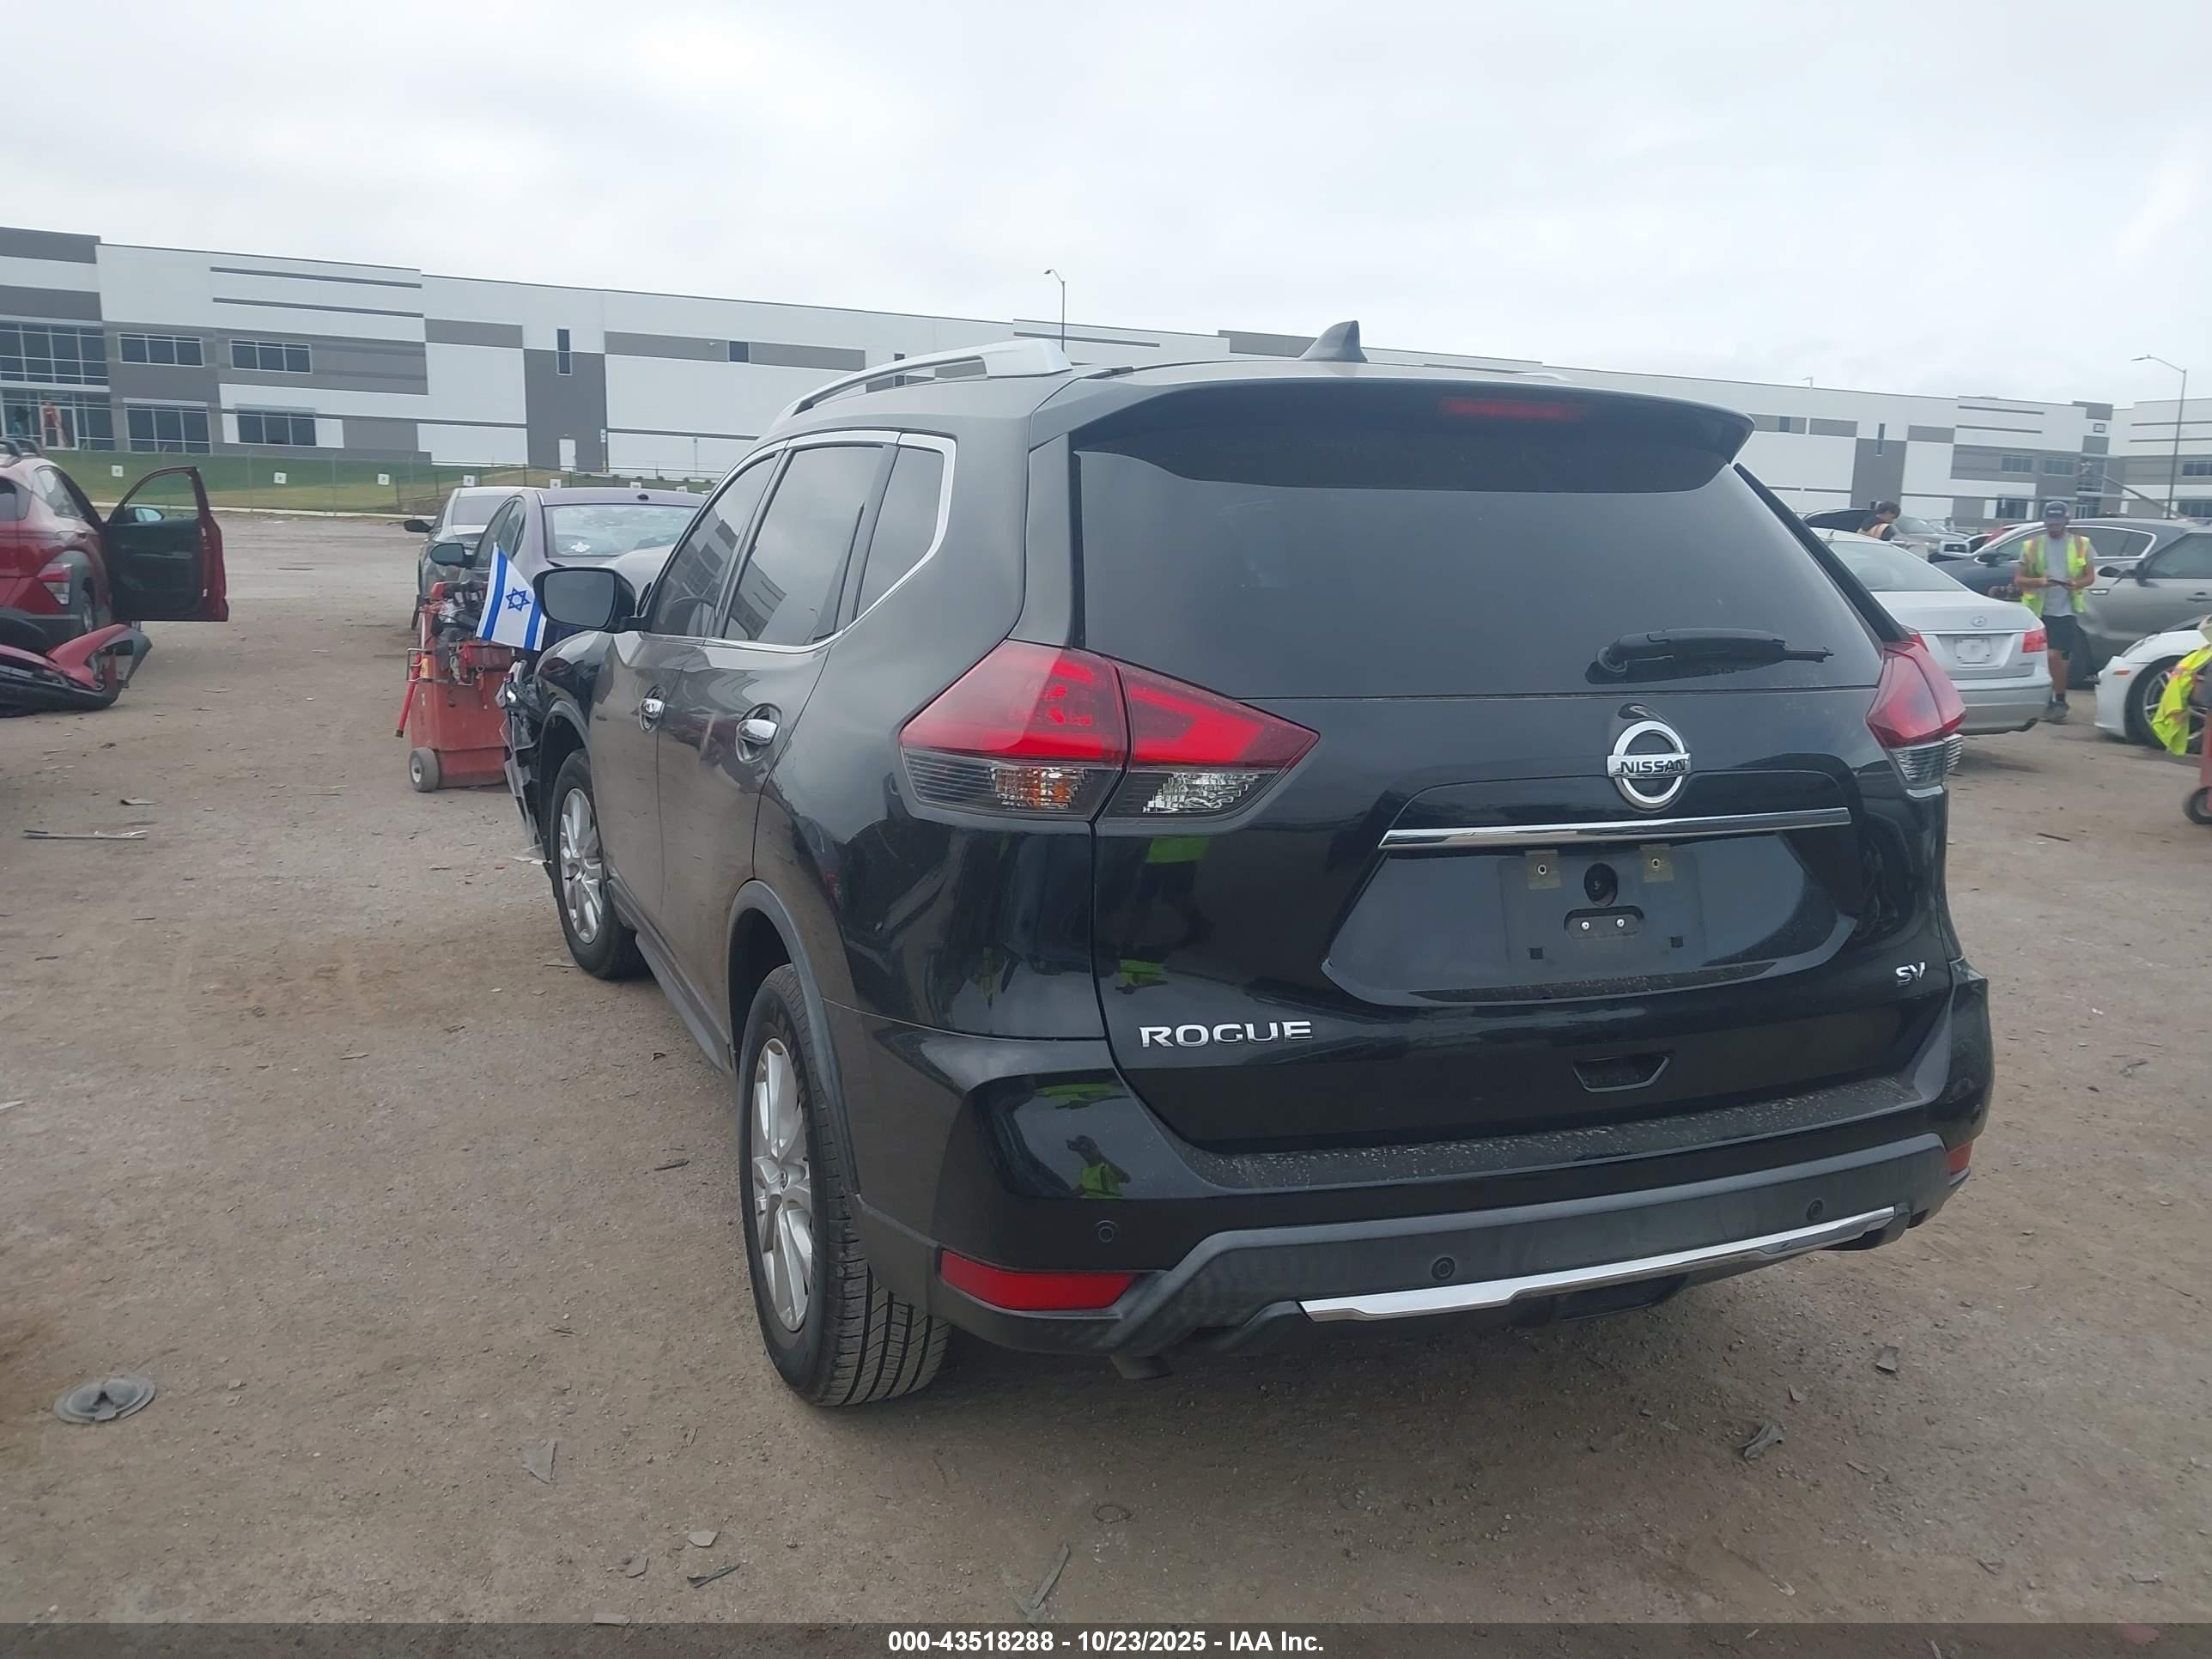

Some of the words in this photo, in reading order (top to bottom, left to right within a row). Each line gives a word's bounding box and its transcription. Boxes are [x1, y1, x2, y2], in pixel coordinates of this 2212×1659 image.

[1620, 759, 1686, 774] NISSAN
[1895, 961, 1926, 986] SV
[1139, 1020, 1313, 1048] ROGUE
